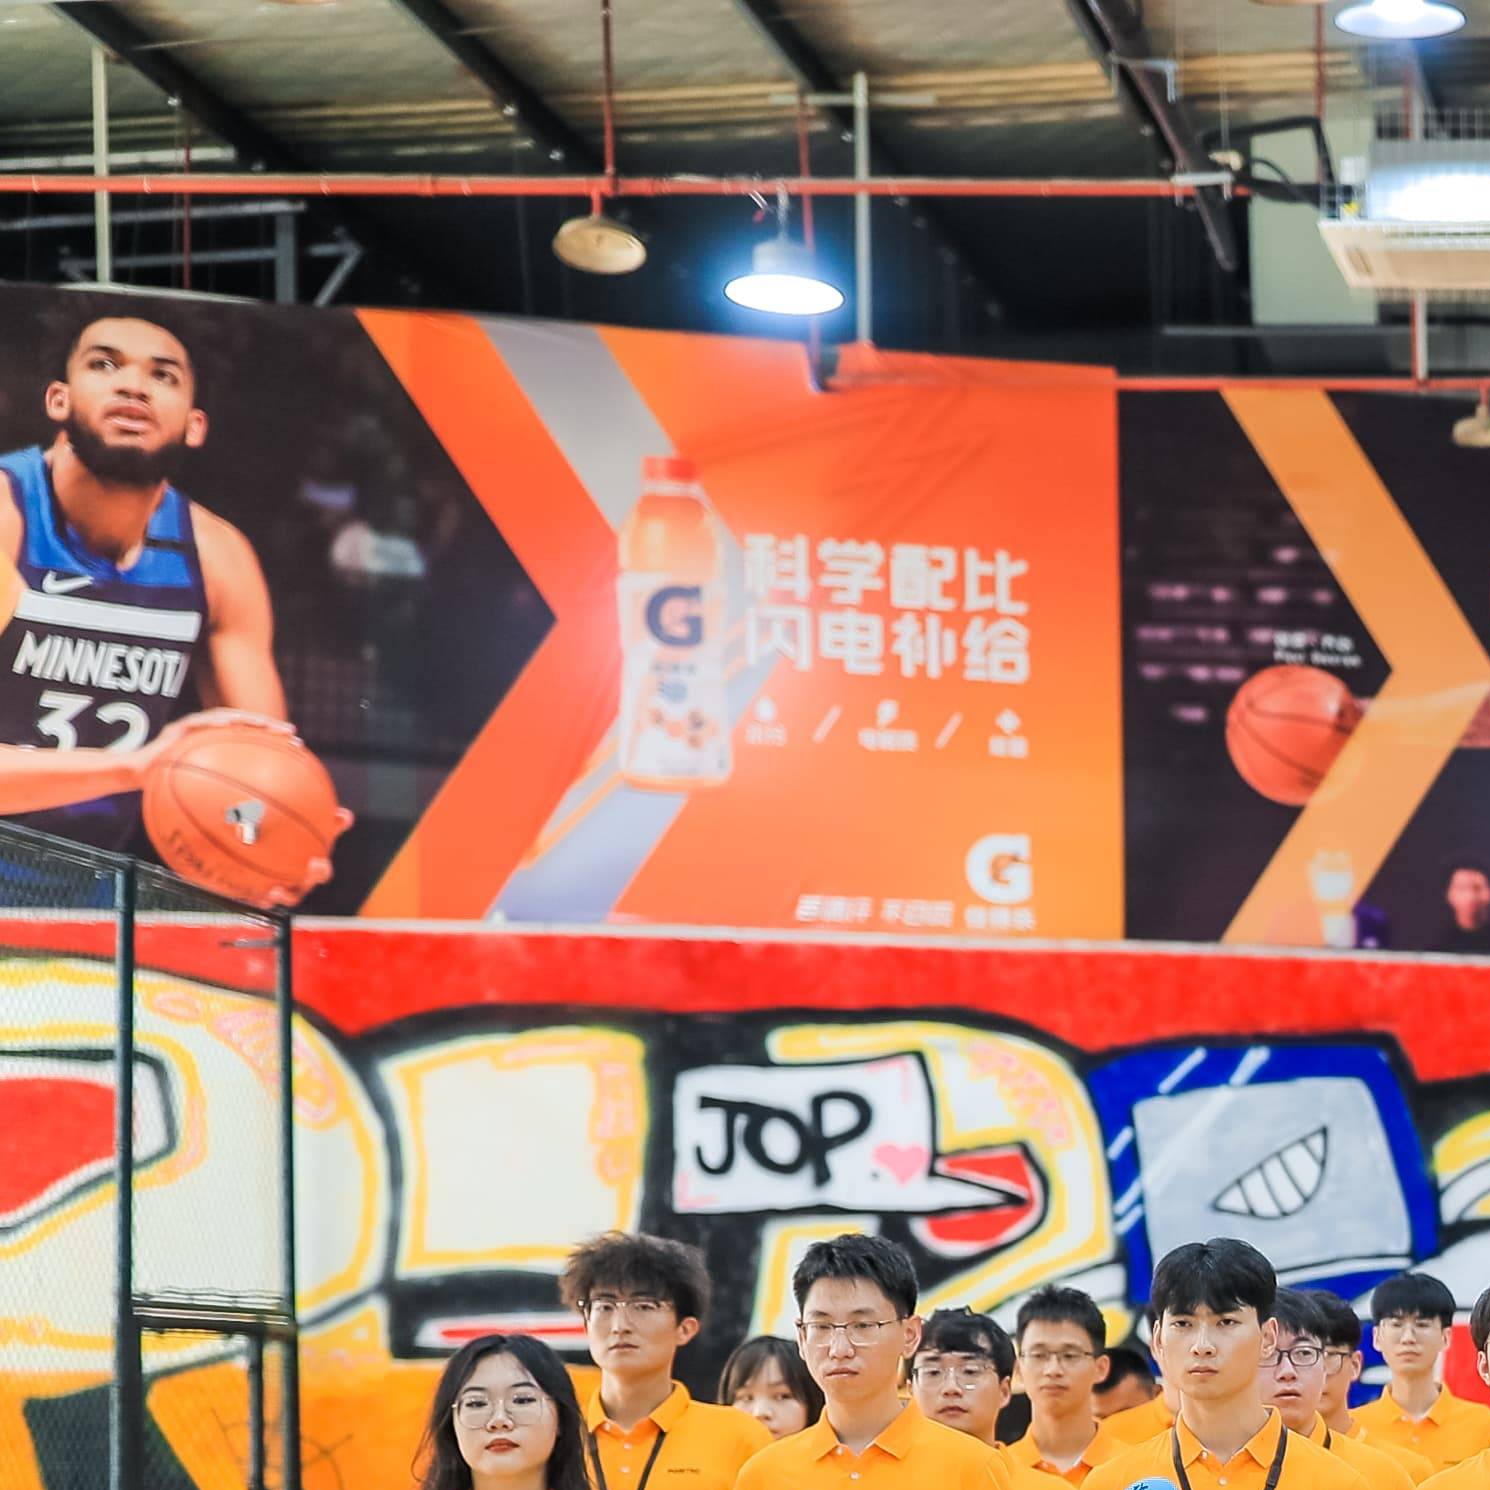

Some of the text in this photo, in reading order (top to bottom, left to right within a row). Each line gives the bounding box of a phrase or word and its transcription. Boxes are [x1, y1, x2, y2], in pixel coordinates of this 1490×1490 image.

[744, 533, 1029, 615] 科学配比
[744, 606, 1030, 684] 闪电补给
[37, 690, 149, 751] 32
[696, 1090, 873, 1188] JOP
